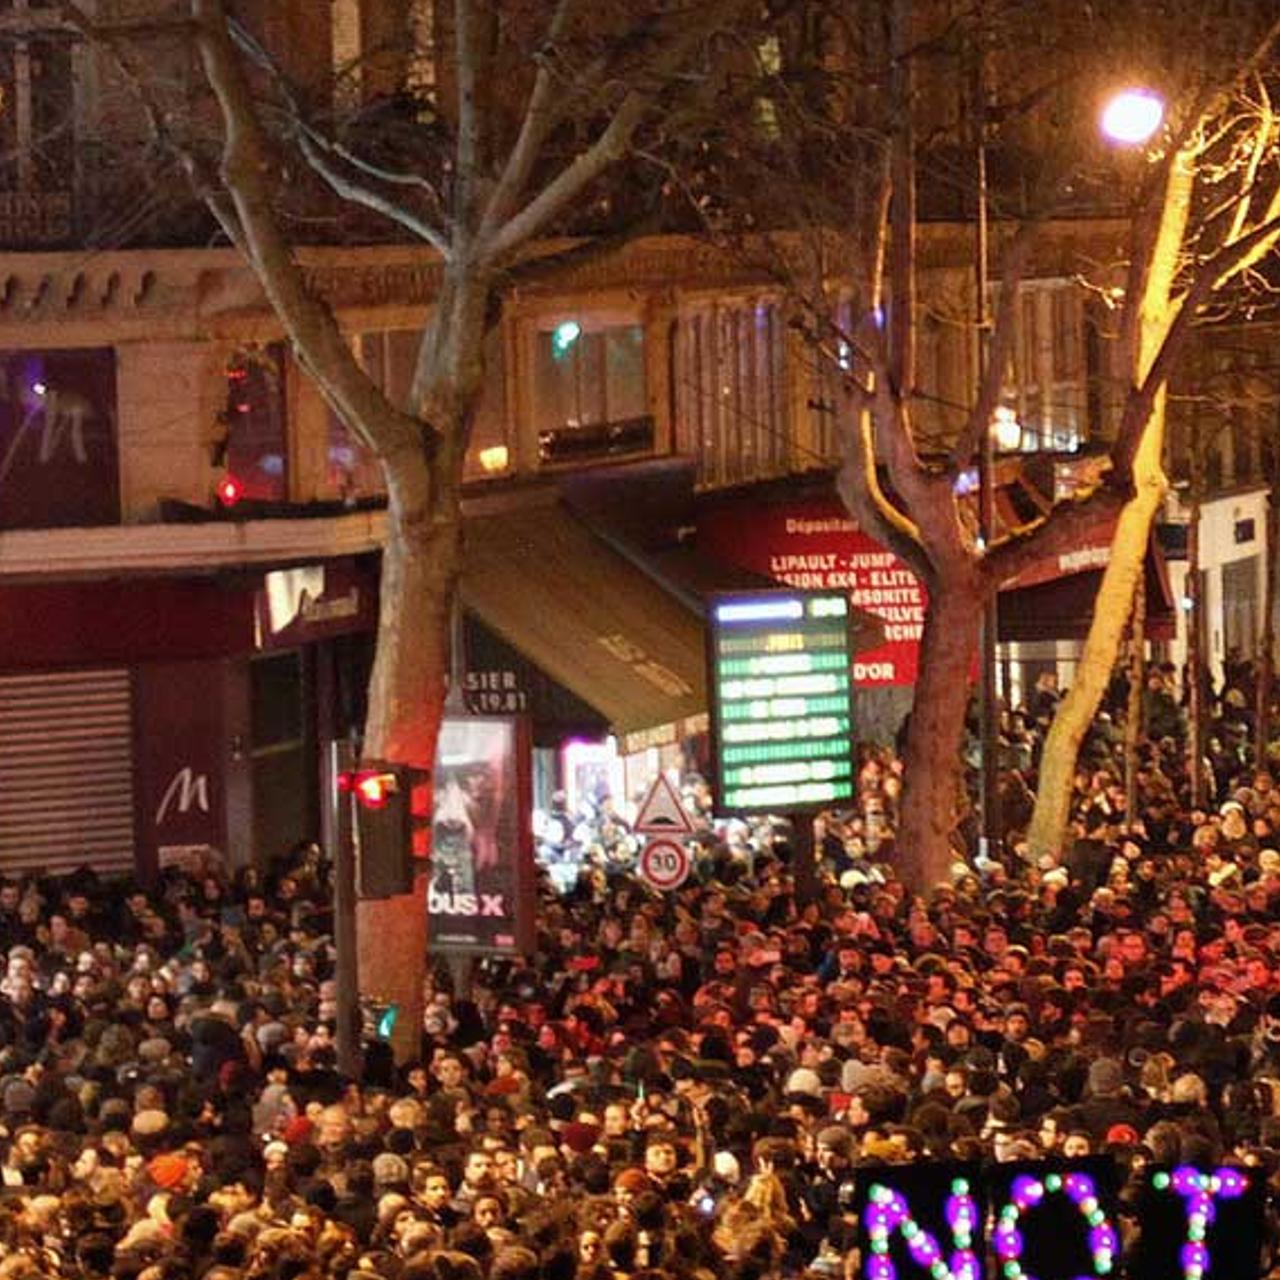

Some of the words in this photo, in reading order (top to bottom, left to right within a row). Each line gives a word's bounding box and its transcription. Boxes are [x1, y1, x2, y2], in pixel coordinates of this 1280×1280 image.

[771, 554, 837, 571] LIPAULT
[850, 552, 896, 568] JUMP
[870, 571, 918, 587] ELITE
[853, 663, 894, 680] D'OR
[651, 853, 677, 872] 30
